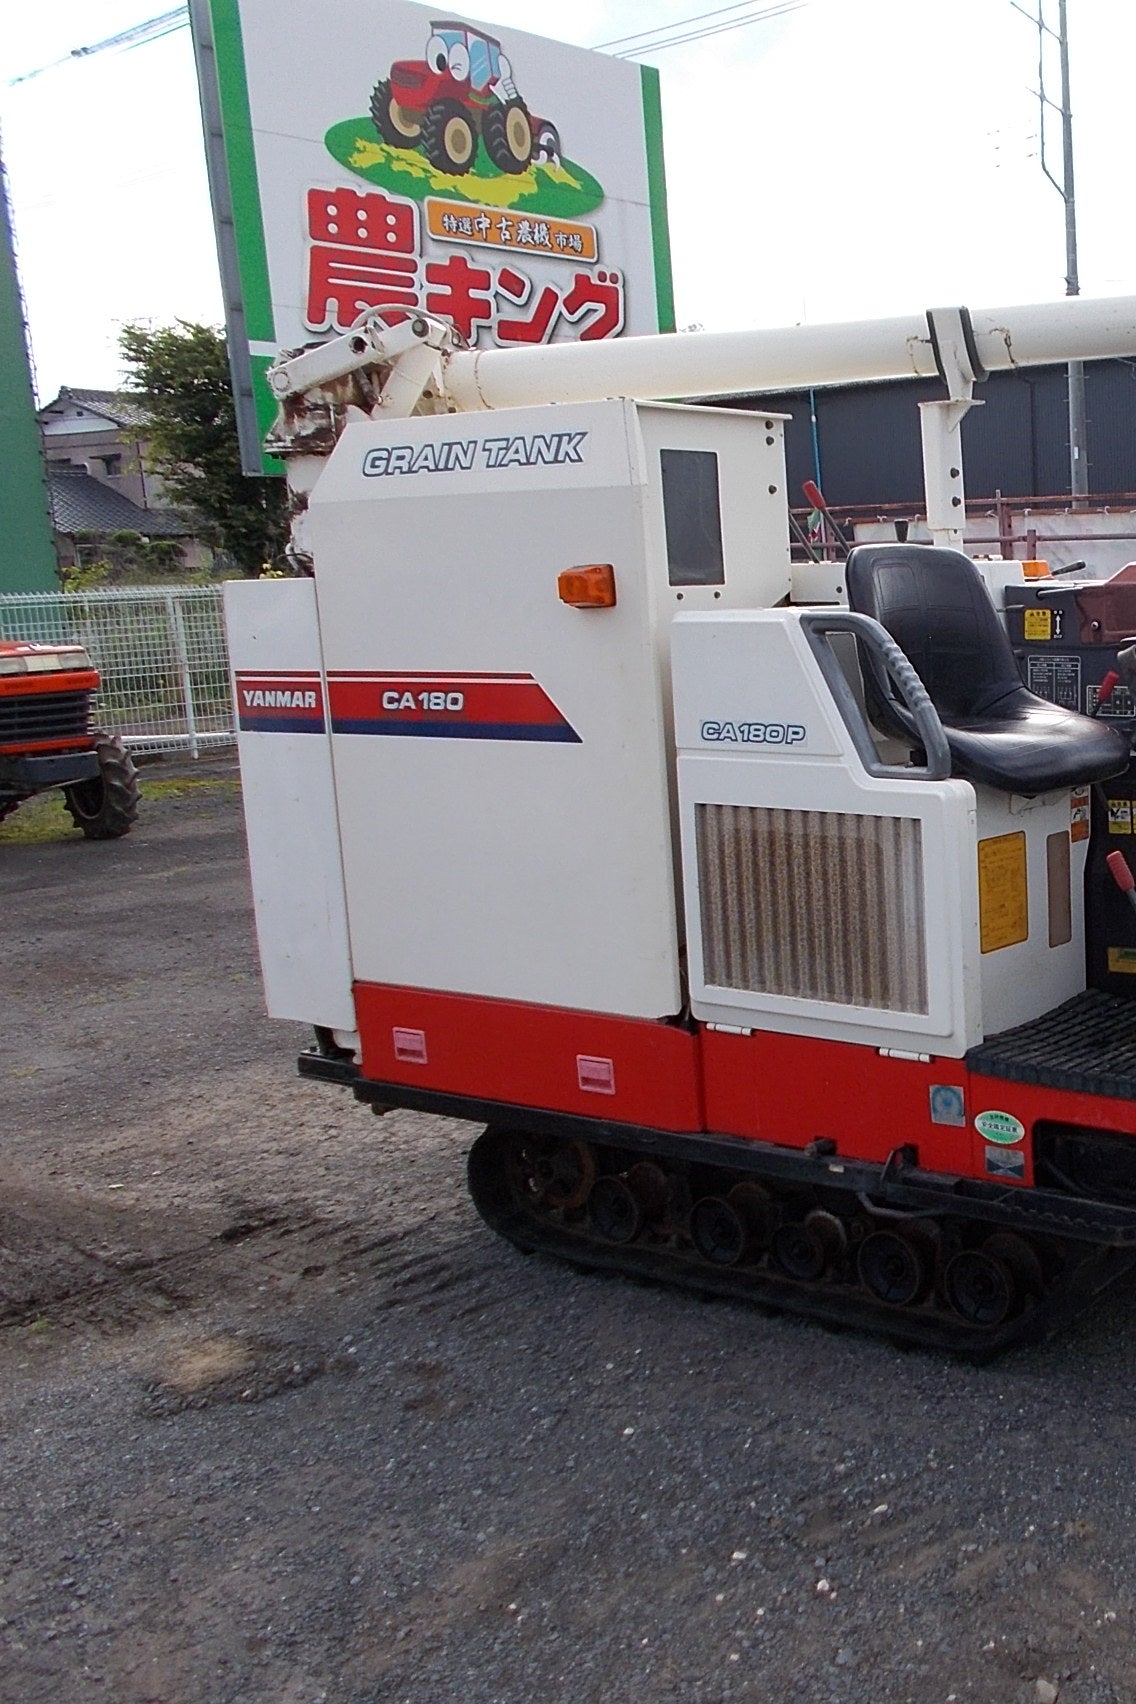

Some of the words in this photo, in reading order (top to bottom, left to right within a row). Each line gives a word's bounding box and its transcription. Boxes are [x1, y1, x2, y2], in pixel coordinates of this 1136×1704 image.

[362, 440, 478, 477] GRAIN
[483, 431, 588, 468] TANK
[243, 690, 317, 708] YANMAR
